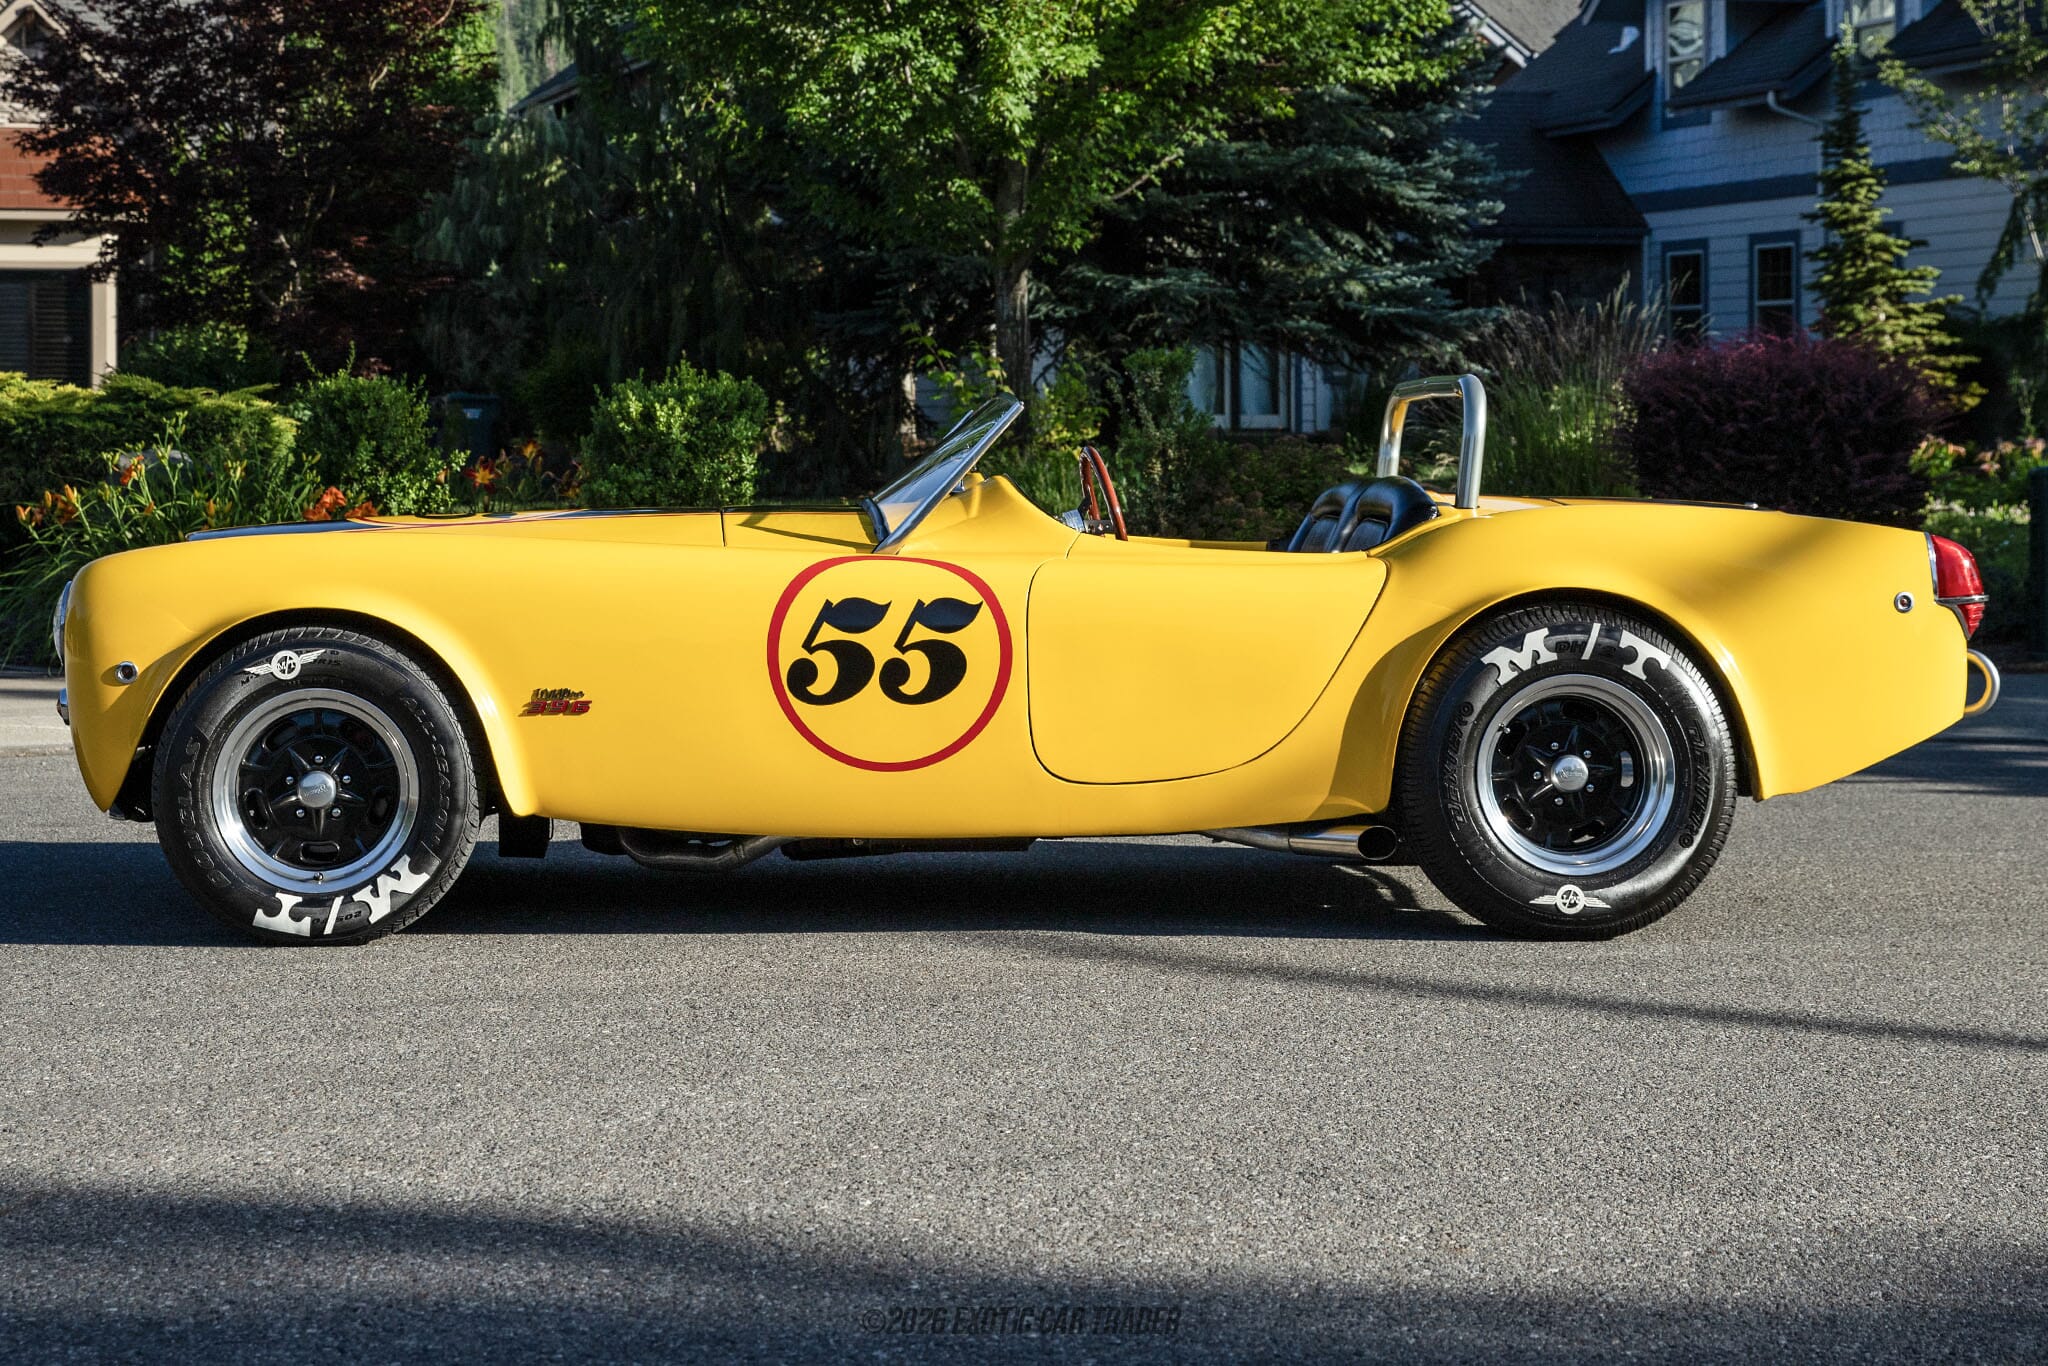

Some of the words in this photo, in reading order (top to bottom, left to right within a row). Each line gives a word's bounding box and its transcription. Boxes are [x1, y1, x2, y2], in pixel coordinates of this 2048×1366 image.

[787, 597, 983, 706] 55
[1480, 622, 1672, 686] M/T
[521, 699, 592, 715] 396
[252, 854, 431, 937] M/T
